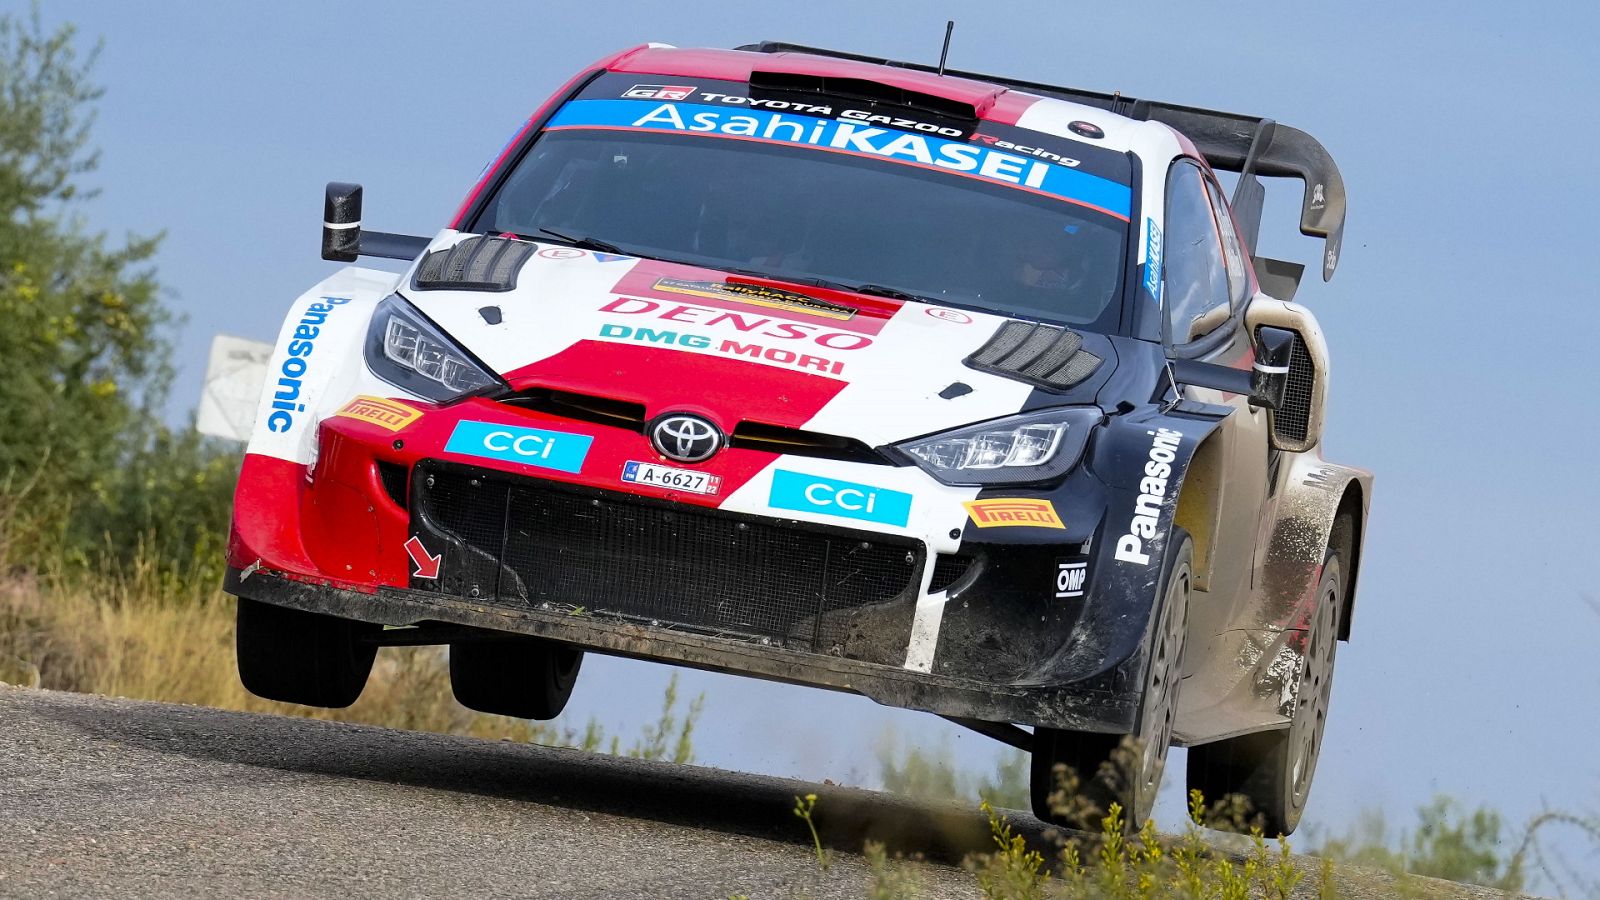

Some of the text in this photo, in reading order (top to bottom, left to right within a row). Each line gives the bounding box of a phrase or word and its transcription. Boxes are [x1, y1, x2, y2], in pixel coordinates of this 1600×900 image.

[625, 88, 1082, 168] GR TOYOTA GAZOO Racing
[598, 297, 874, 350] DENSO
[598, 323, 845, 375] DMG MORI
[267, 296, 353, 433] Panasonic
[344, 399, 412, 425] PIRELLI
[643, 468, 704, 489] A-6627
[1114, 427, 1184, 566] Panasonic
[971, 503, 1056, 524] PIRELLI
[1057, 568, 1086, 591] OMP
